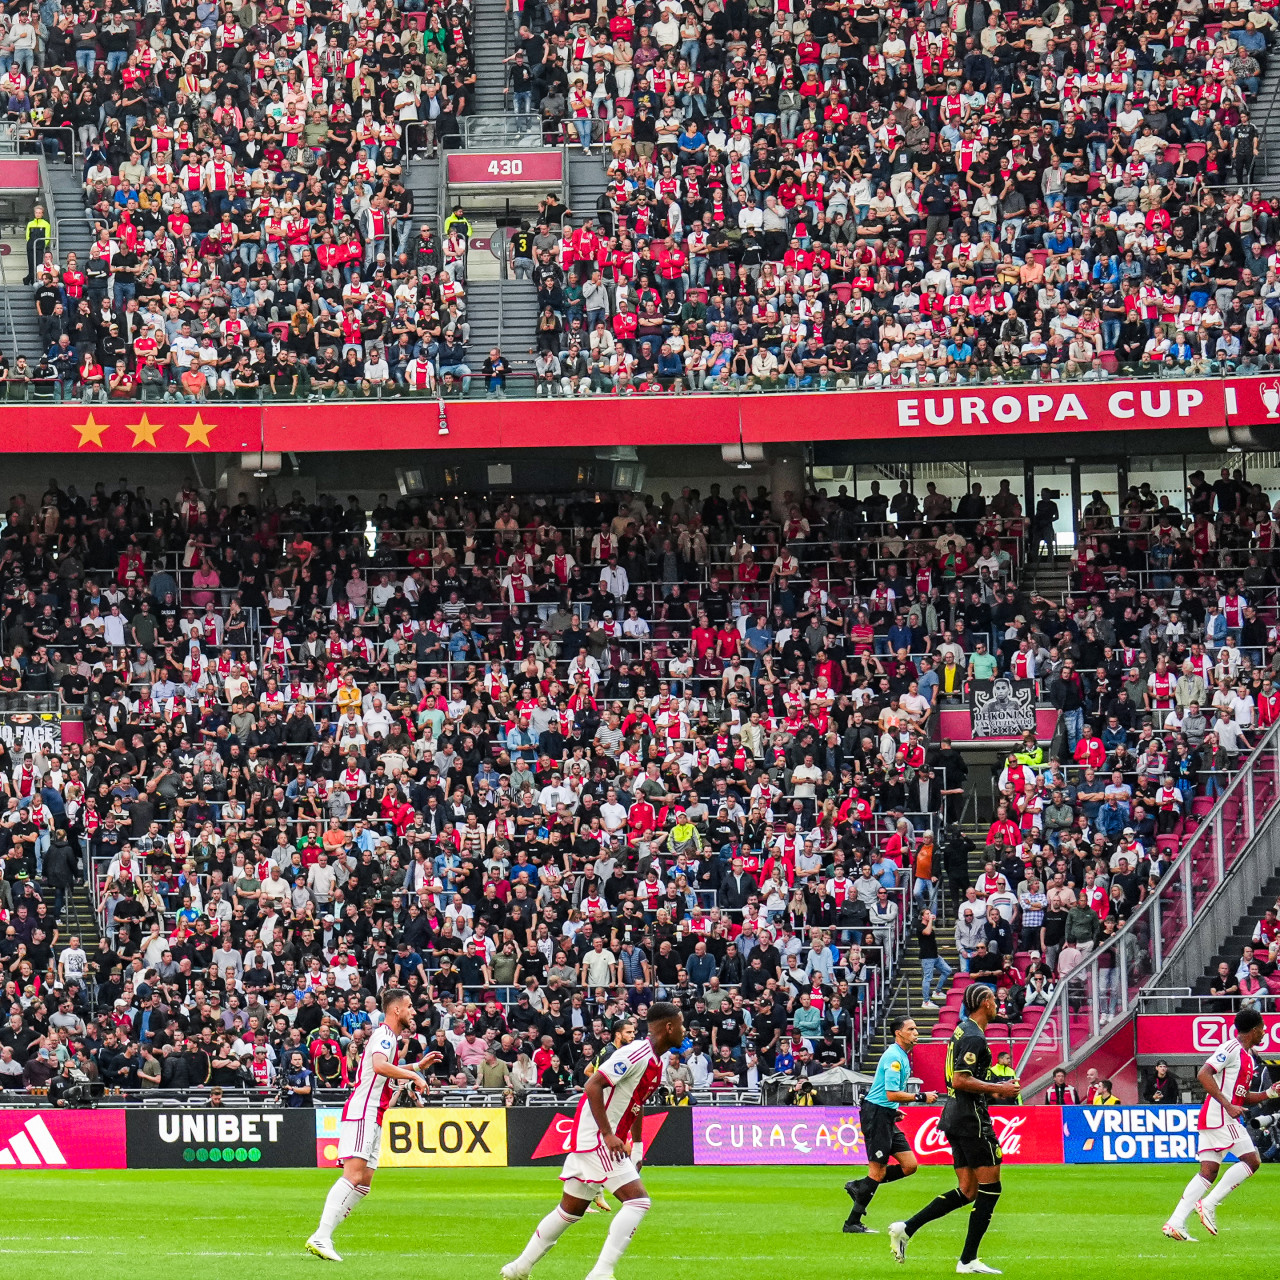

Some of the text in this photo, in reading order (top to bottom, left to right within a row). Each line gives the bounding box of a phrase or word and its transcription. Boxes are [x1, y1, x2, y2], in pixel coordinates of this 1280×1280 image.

[488, 159, 523, 175] 430
[519, 239, 527, 251] 3
[897, 387, 1237, 427] EUROPA CUP I
[975, 710, 1033, 721] DE KONING
[158, 1114, 284, 1143] UNIBET
[1083, 1109, 1199, 1133] VRIENDE
[390, 1120, 491, 1154] BLOX
[705, 1123, 858, 1154] CURAÇAO
[1103, 1134, 1197, 1161] LOTERI
